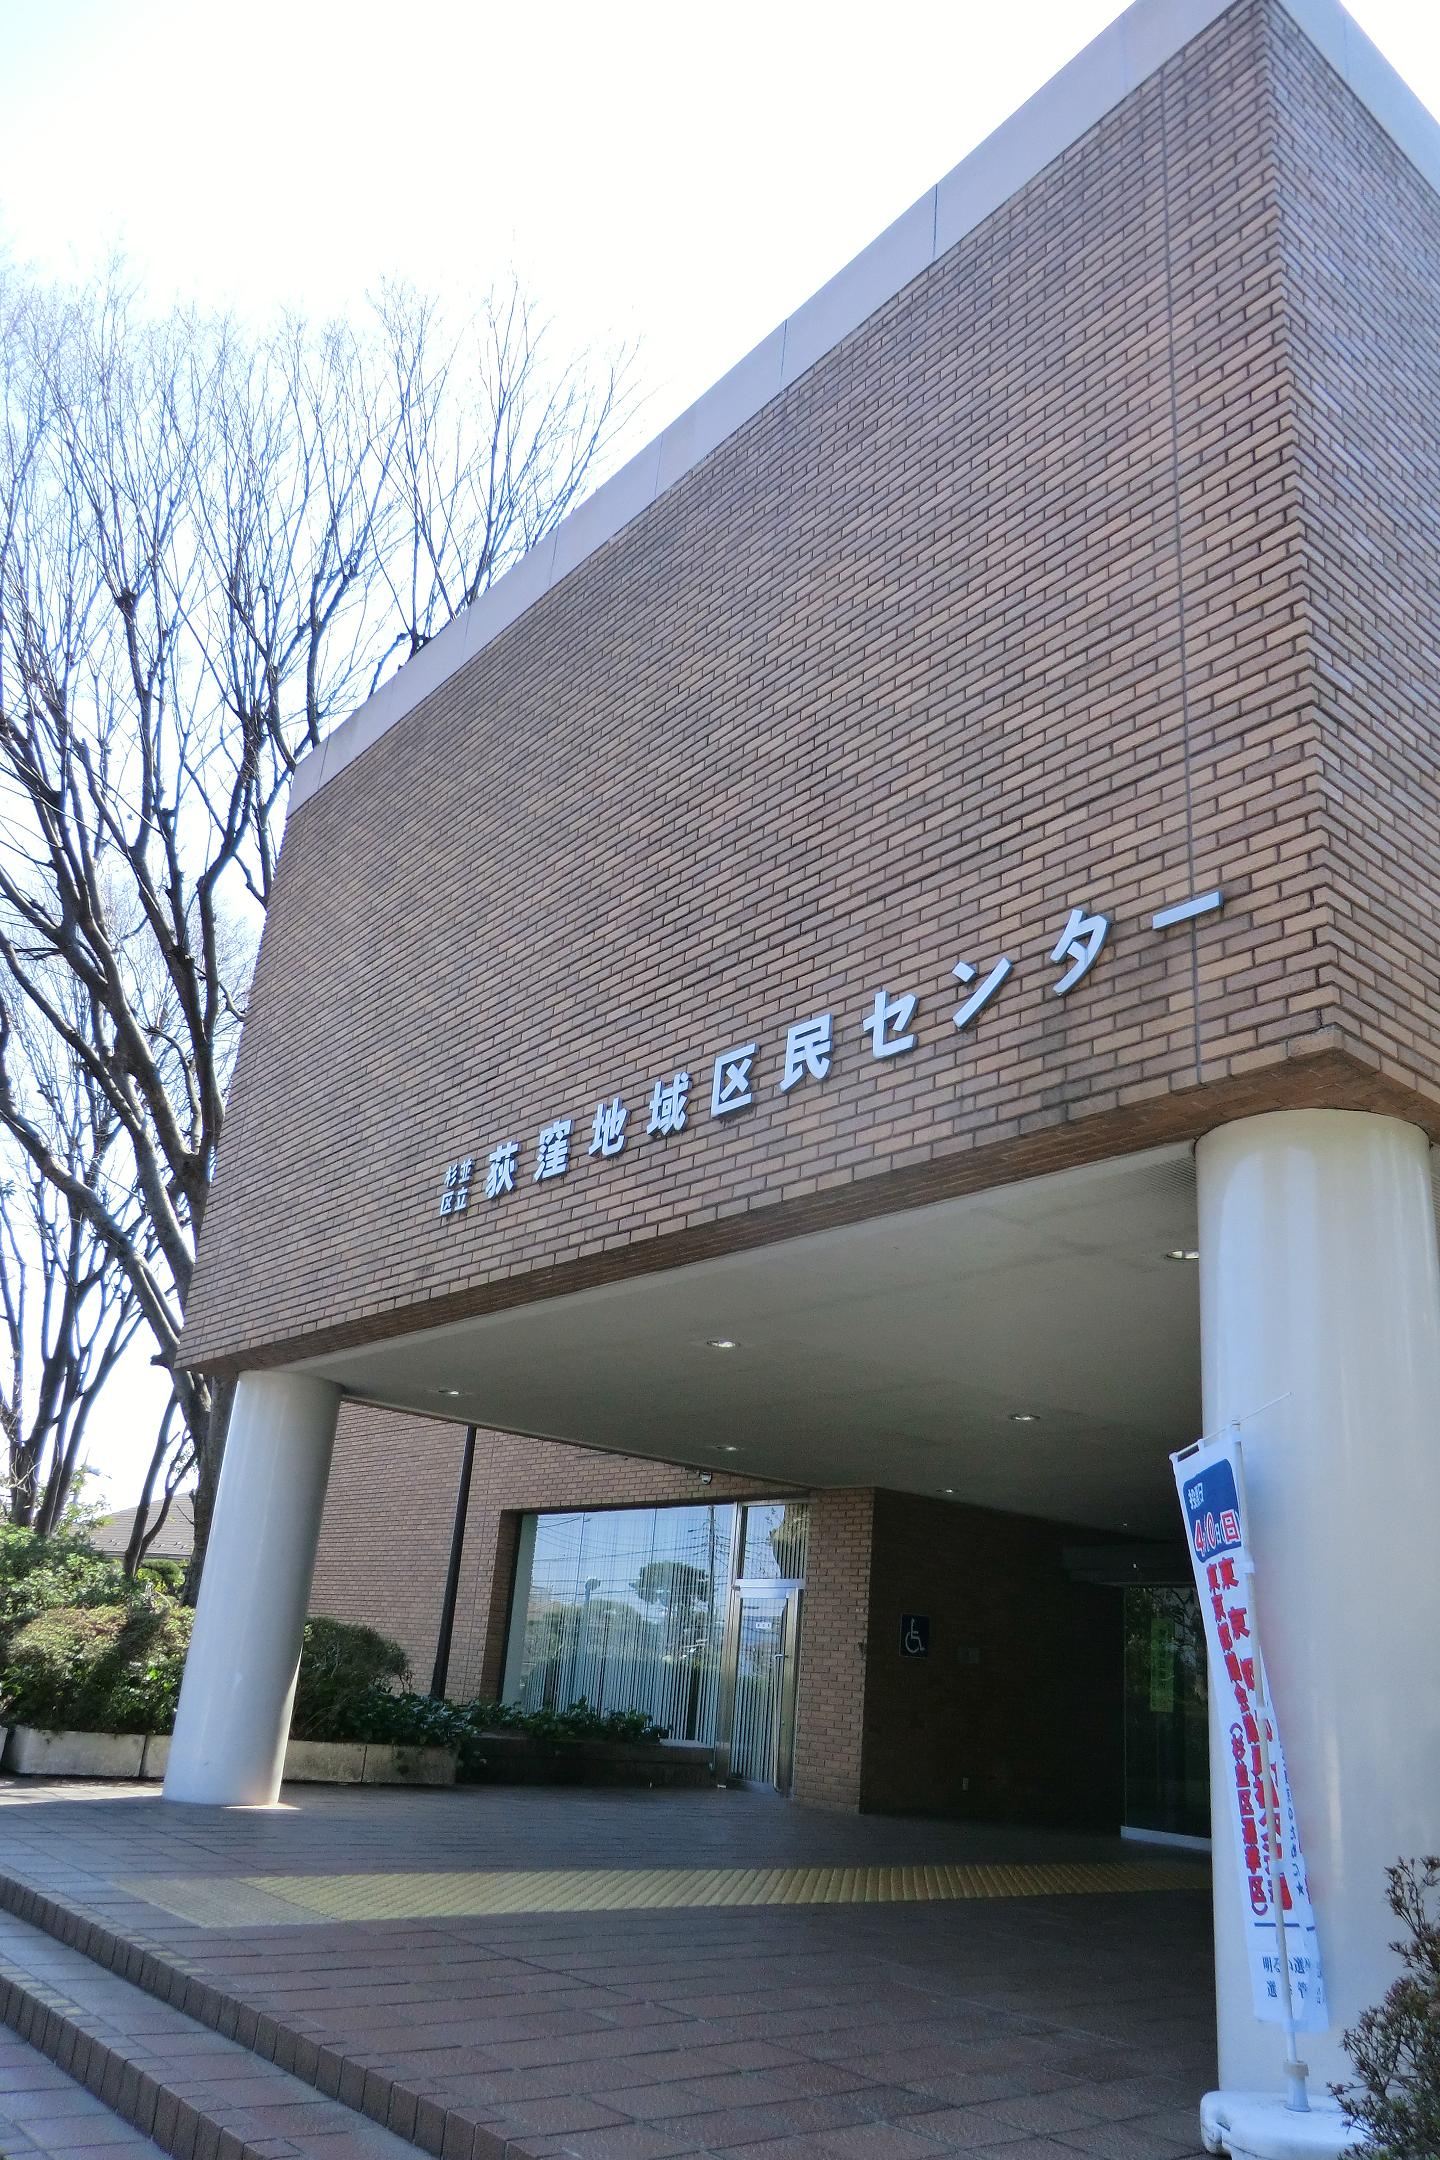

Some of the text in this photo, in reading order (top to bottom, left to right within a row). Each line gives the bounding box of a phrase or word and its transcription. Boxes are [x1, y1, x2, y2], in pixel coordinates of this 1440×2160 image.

[486, 889, 1225, 1199] 荻窪地域区民センター
[444, 1158, 473, 1187] 杉並
[440, 1186, 469, 1216] 区立
